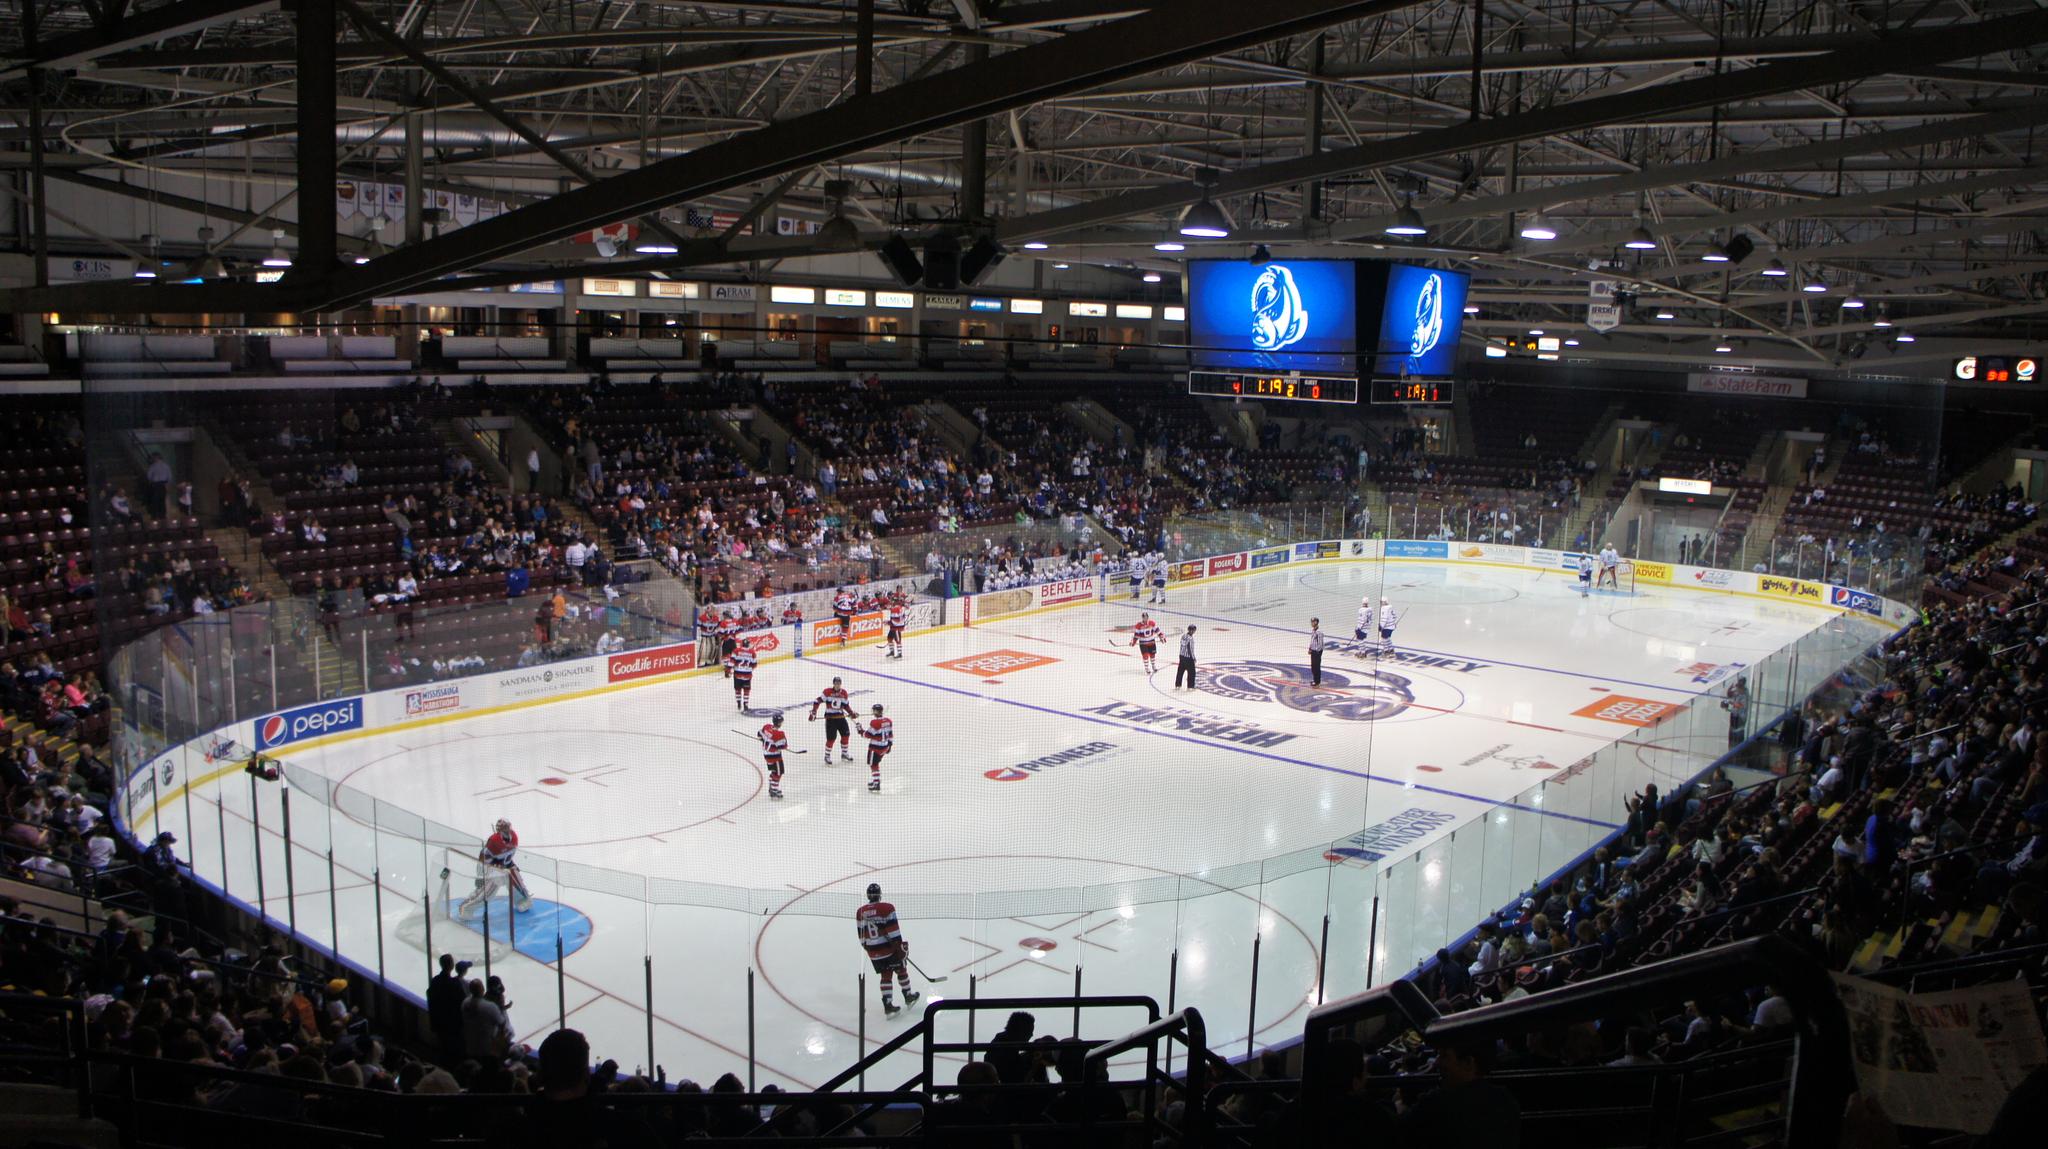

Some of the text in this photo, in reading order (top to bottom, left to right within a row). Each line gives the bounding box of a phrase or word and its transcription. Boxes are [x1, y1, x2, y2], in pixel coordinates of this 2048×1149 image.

[1232, 381, 1241, 394] 4
[1257, 379, 1282, 394] 1:19
[1286, 384, 1295, 398] 2
[1311, 385, 1320, 399] 0
[1636, 568, 1665, 579] ADVICE
[1041, 578, 1093, 598] BERETTA
[815, 624, 842, 644] pizz
[850, 617, 882, 639] pizza
[612, 653, 691, 675] GoodLife FITNESS
[499, 665, 595, 687] SANDMAN SIGNATURE
[422, 686, 459, 700] MISSISSAUGA
[293, 702, 354, 738] pepsi
[1015, 741, 1119, 772] PIONEER
[1367, 811, 1456, 852] WINDOWS
